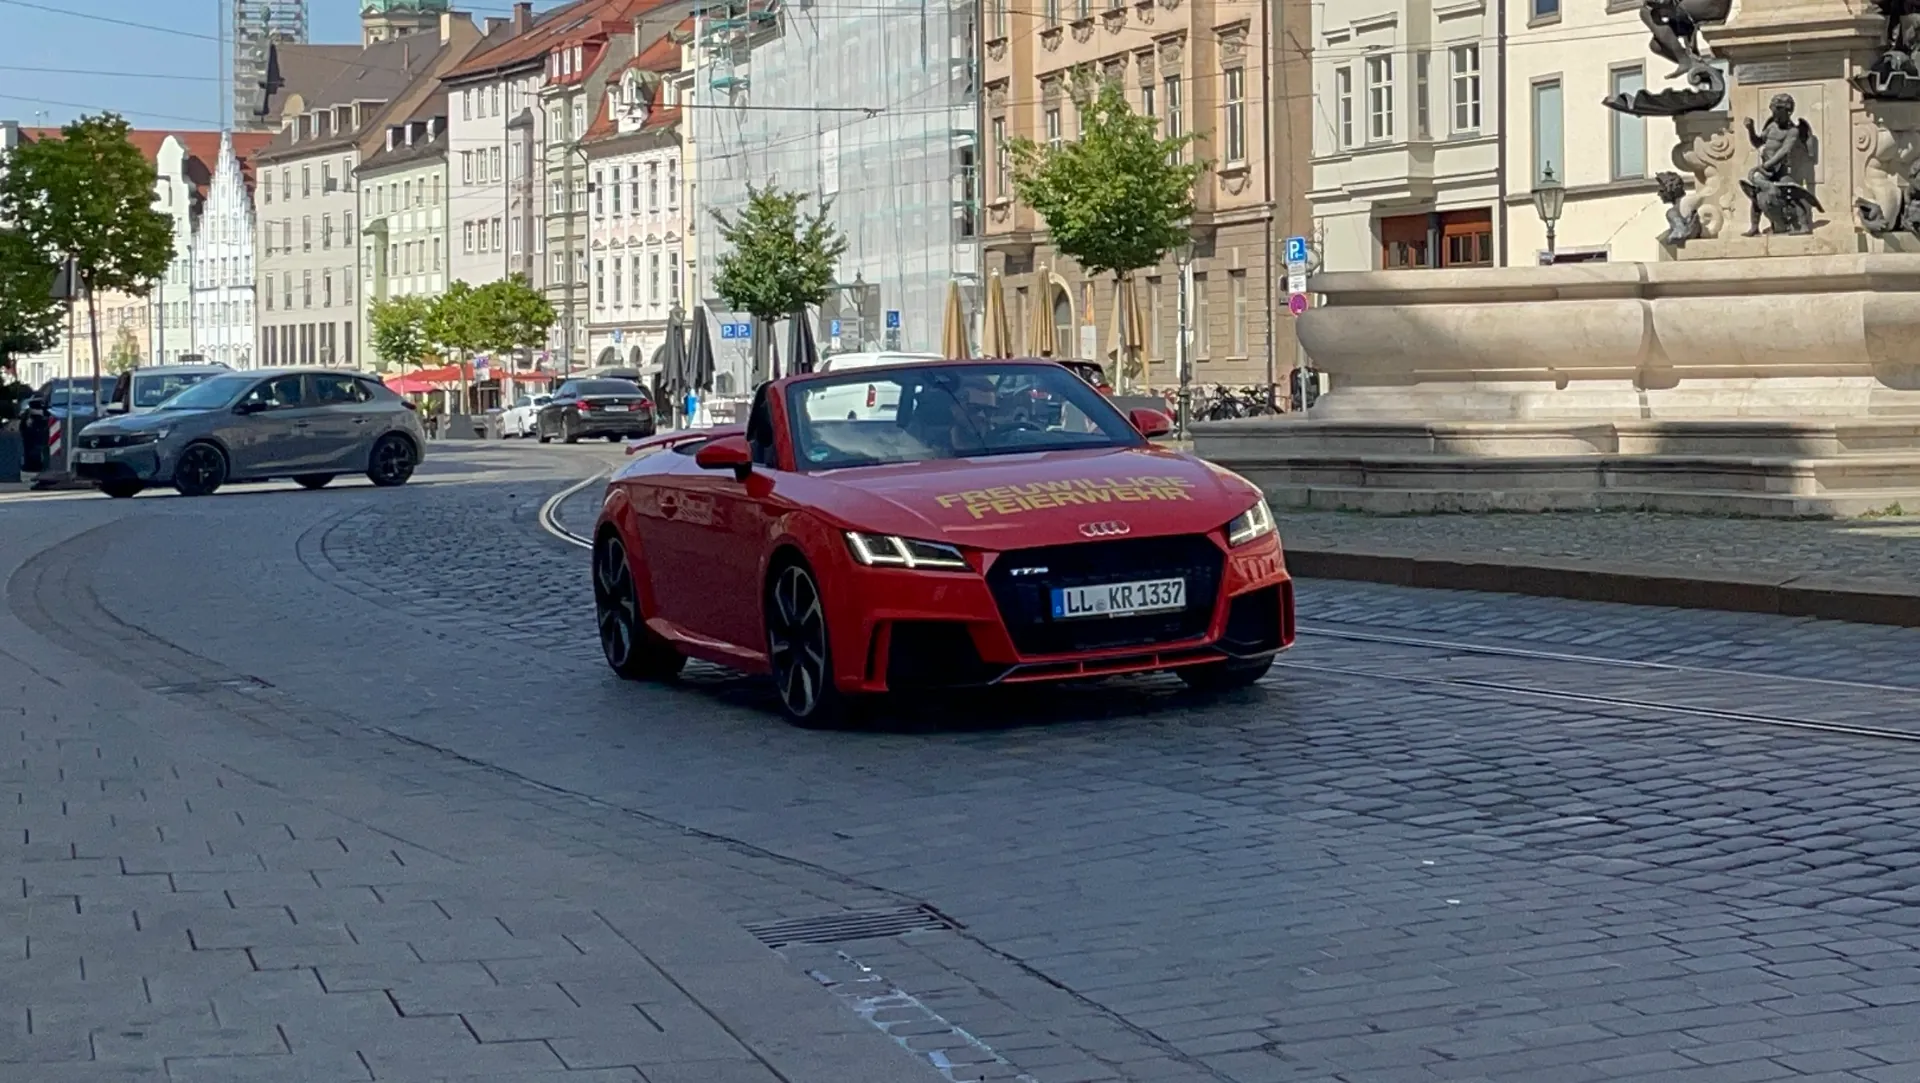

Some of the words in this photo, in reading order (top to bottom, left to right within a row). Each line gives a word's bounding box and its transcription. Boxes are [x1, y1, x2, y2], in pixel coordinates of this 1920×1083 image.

[1289, 241, 1300, 259] P
[966, 487, 1193, 519] FEIERWEHR
[1066, 589, 1093, 613] LL
[1109, 585, 1134, 610] KR
[1137, 580, 1183, 607] 1337
